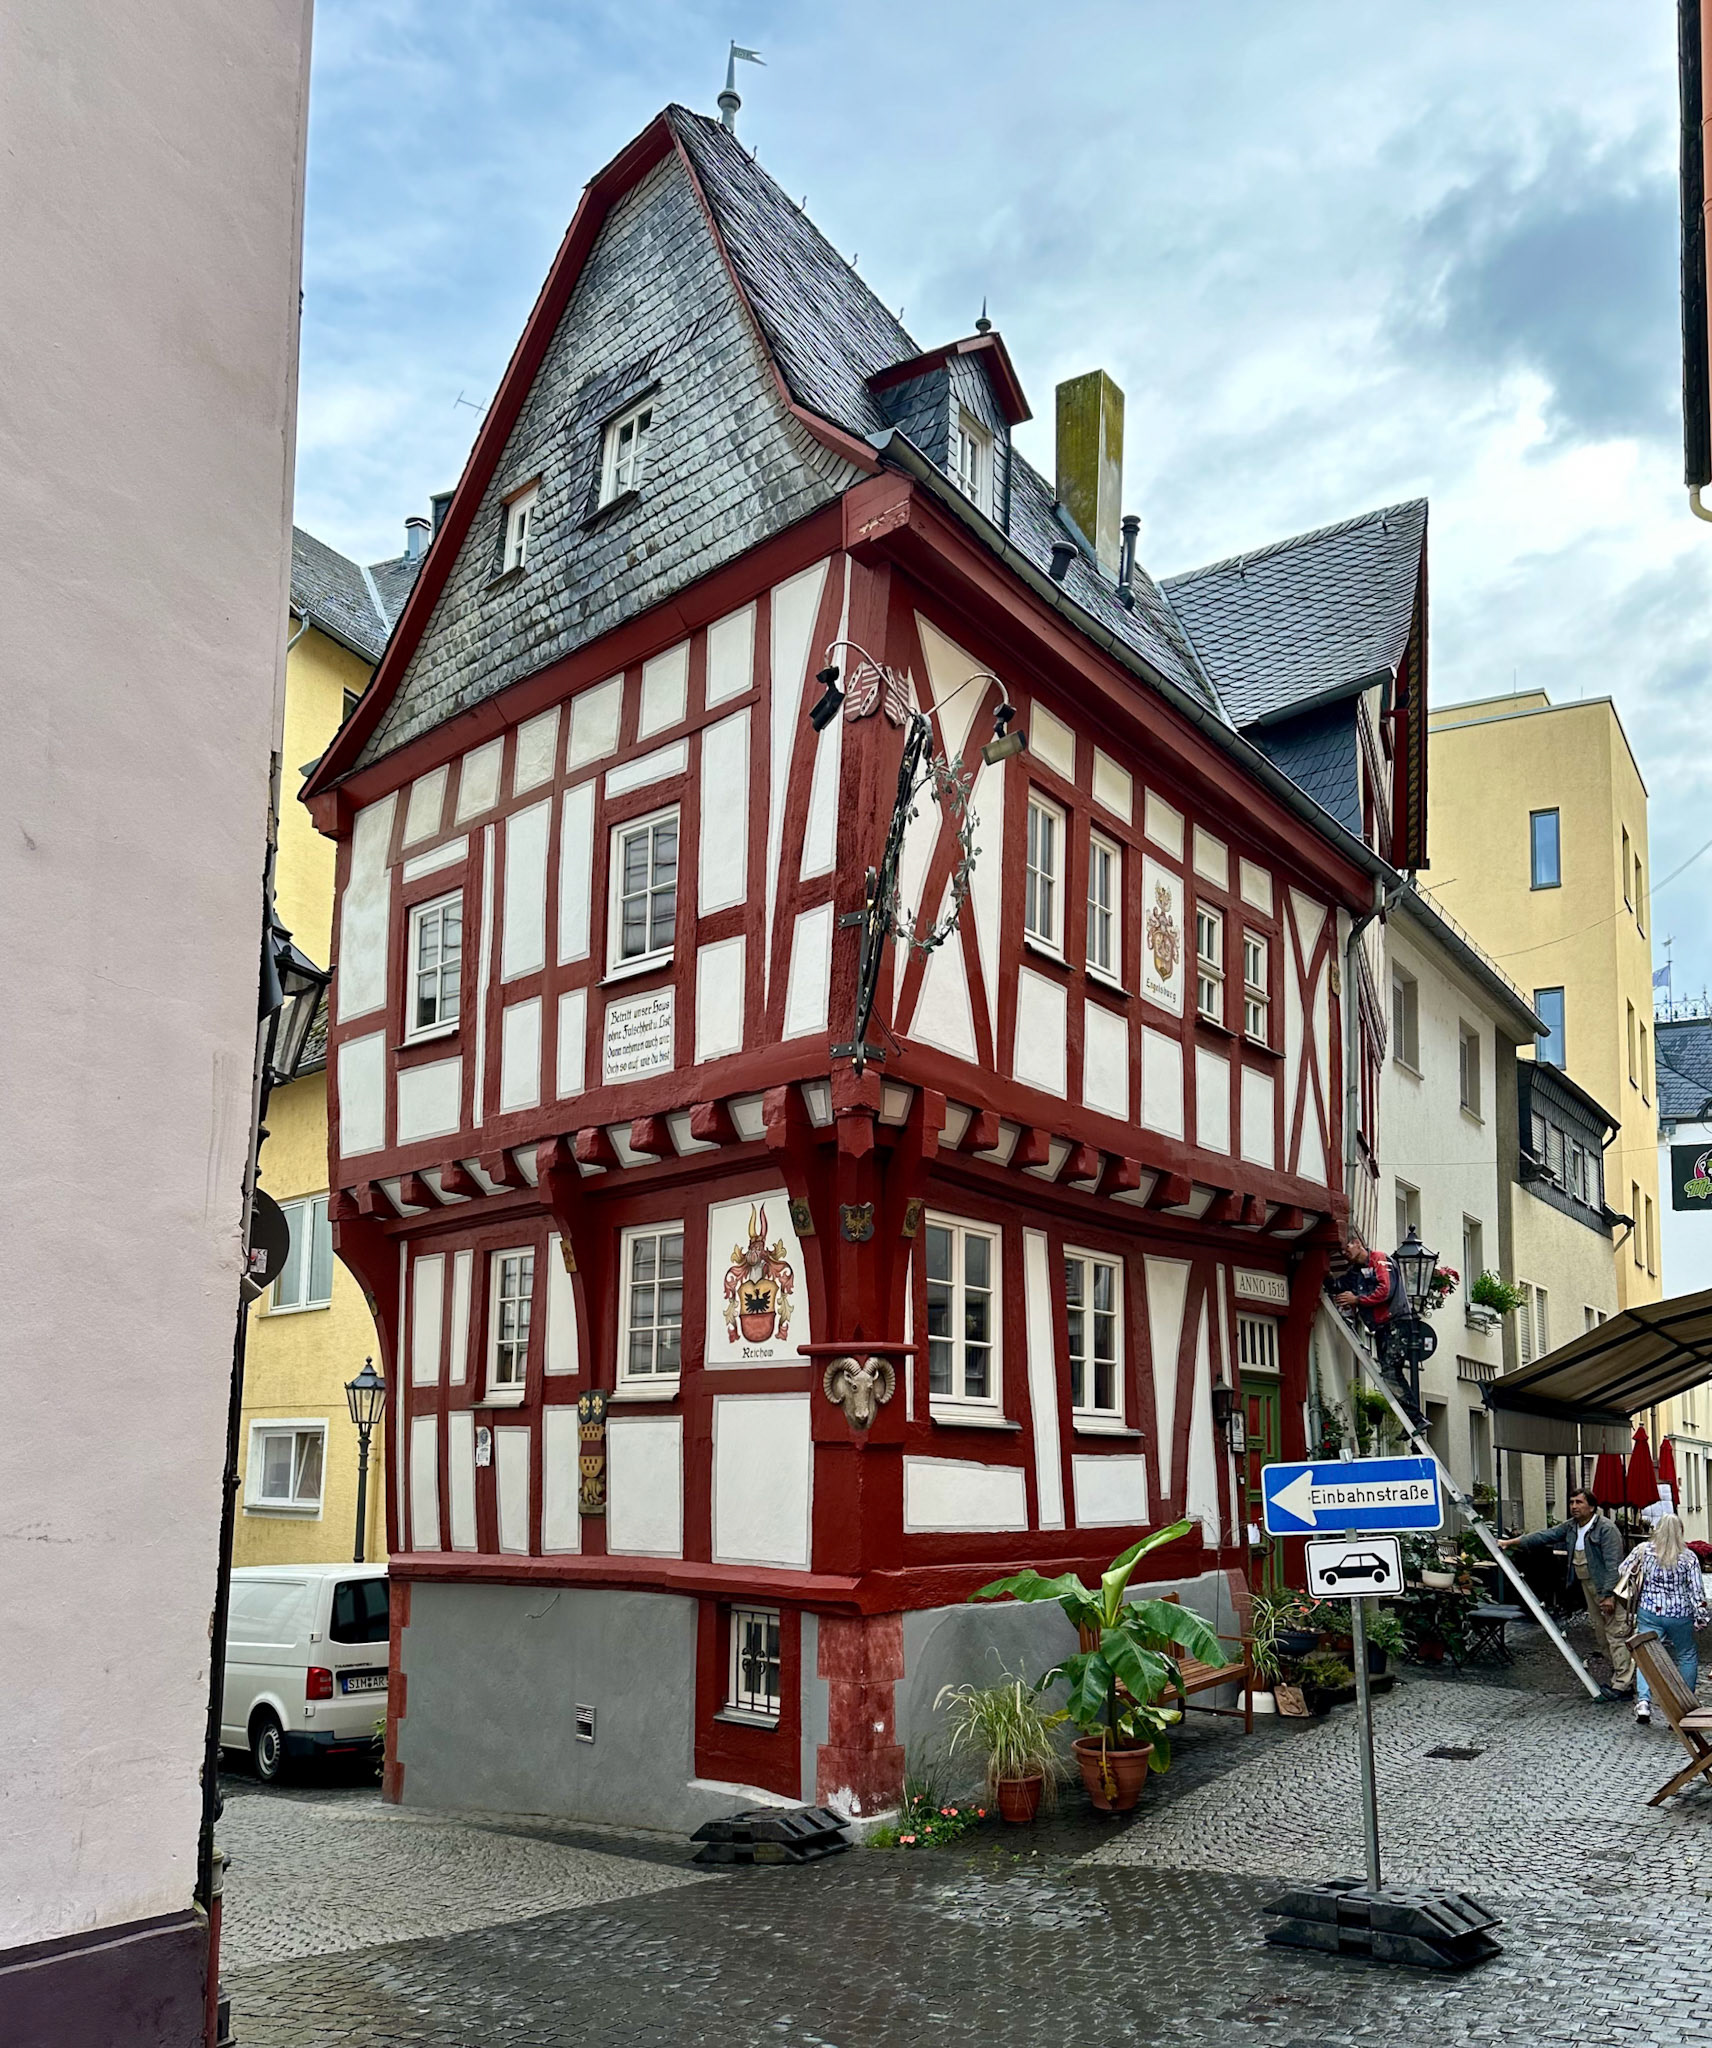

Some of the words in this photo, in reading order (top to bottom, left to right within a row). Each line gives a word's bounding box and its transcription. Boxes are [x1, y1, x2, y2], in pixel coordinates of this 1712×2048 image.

[1146, 977, 1177, 1004] Engelsburg
[634, 1007, 652, 1018] unser
[652, 999, 670, 1014] Haus
[608, 1029, 622, 1042] ohne
[658, 1014, 671, 1029] List
[622, 1041, 645, 1056] nehmen
[645, 1035, 658, 1050] auch
[620, 1062, 627, 1072] so
[628, 1056, 639, 1072] auf
[651, 1052, 658, 1065] du
[1240, 1274, 1266, 1294] ANNO
[1311, 1485, 1429, 1505] Einbahnstraße
[348, 1678, 367, 1689] SIM
